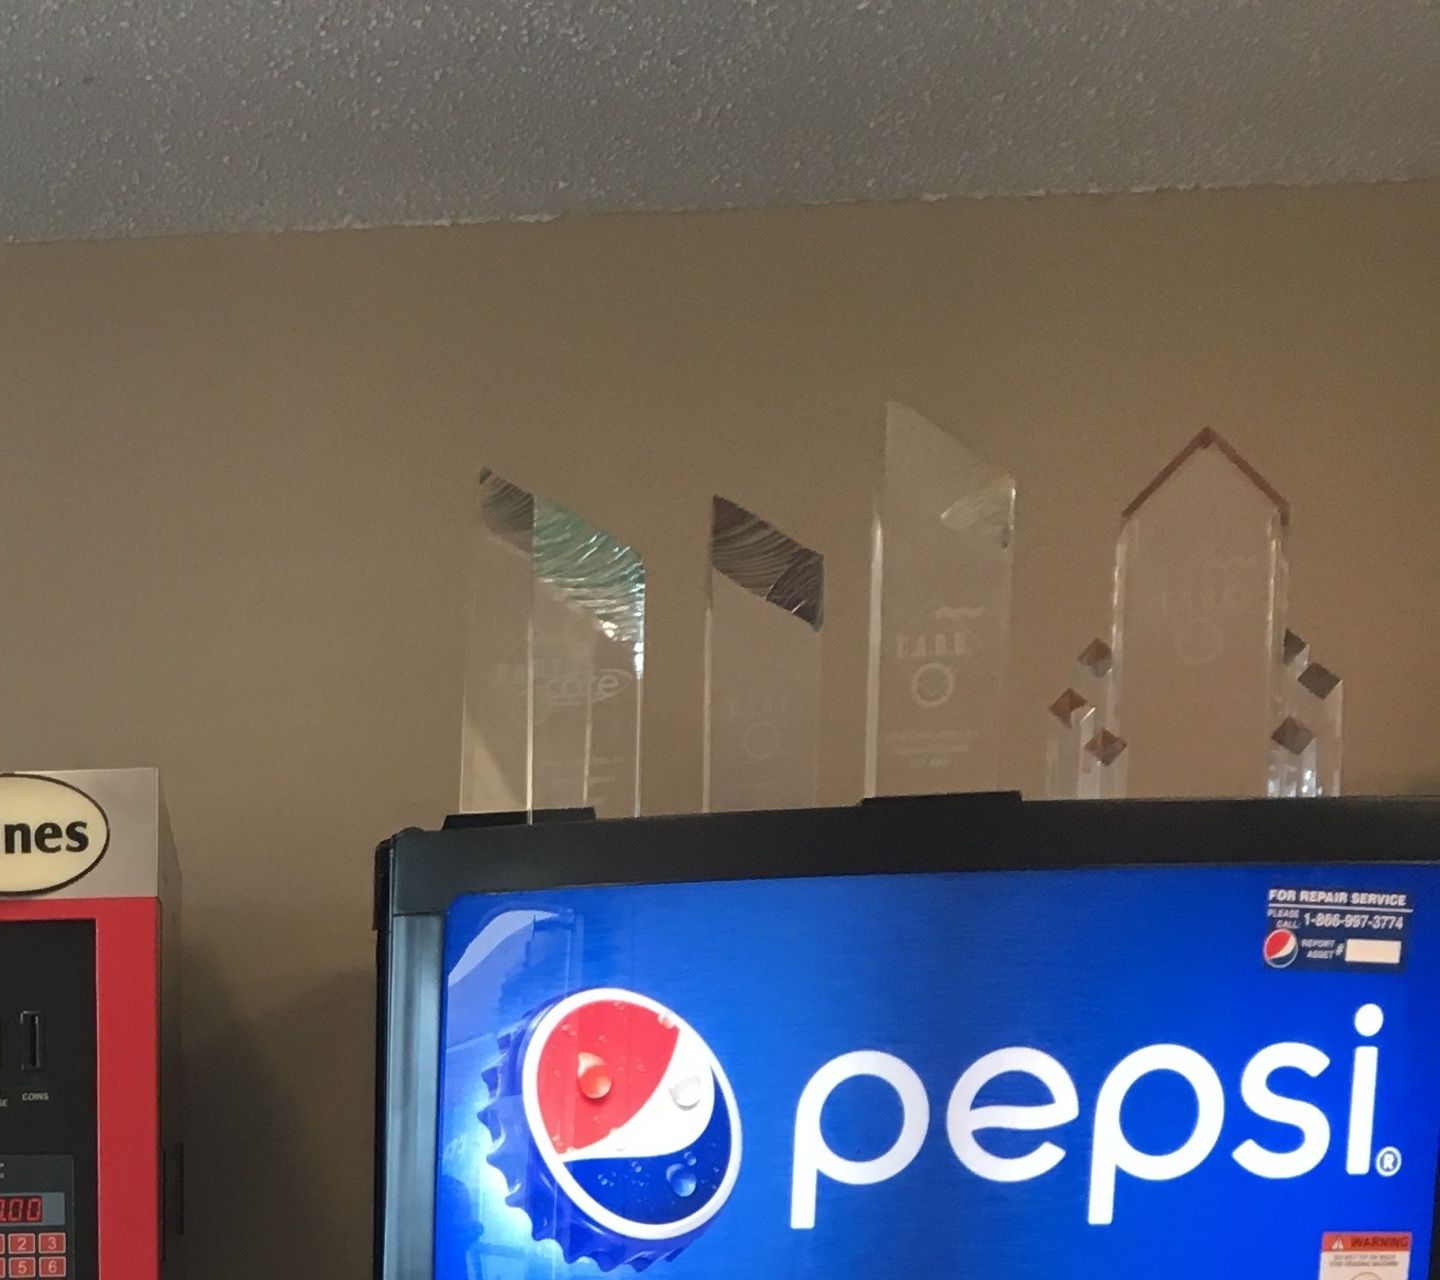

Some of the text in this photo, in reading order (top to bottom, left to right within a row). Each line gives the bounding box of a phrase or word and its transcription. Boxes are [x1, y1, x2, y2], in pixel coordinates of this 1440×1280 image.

[1269, 889, 1406, 906] FOR REPAIR SERVICE
[22, 1092, 49, 1101] COINS
[790, 1004, 1379, 1229] pepsi
[17, 1237, 27, 1250] 2
[48, 1236, 57, 1249] 3
[1351, 1236, 1409, 1248] WARNING
[18, 1261, 27, 1274] 5
[48, 1260, 57, 1273] 6
